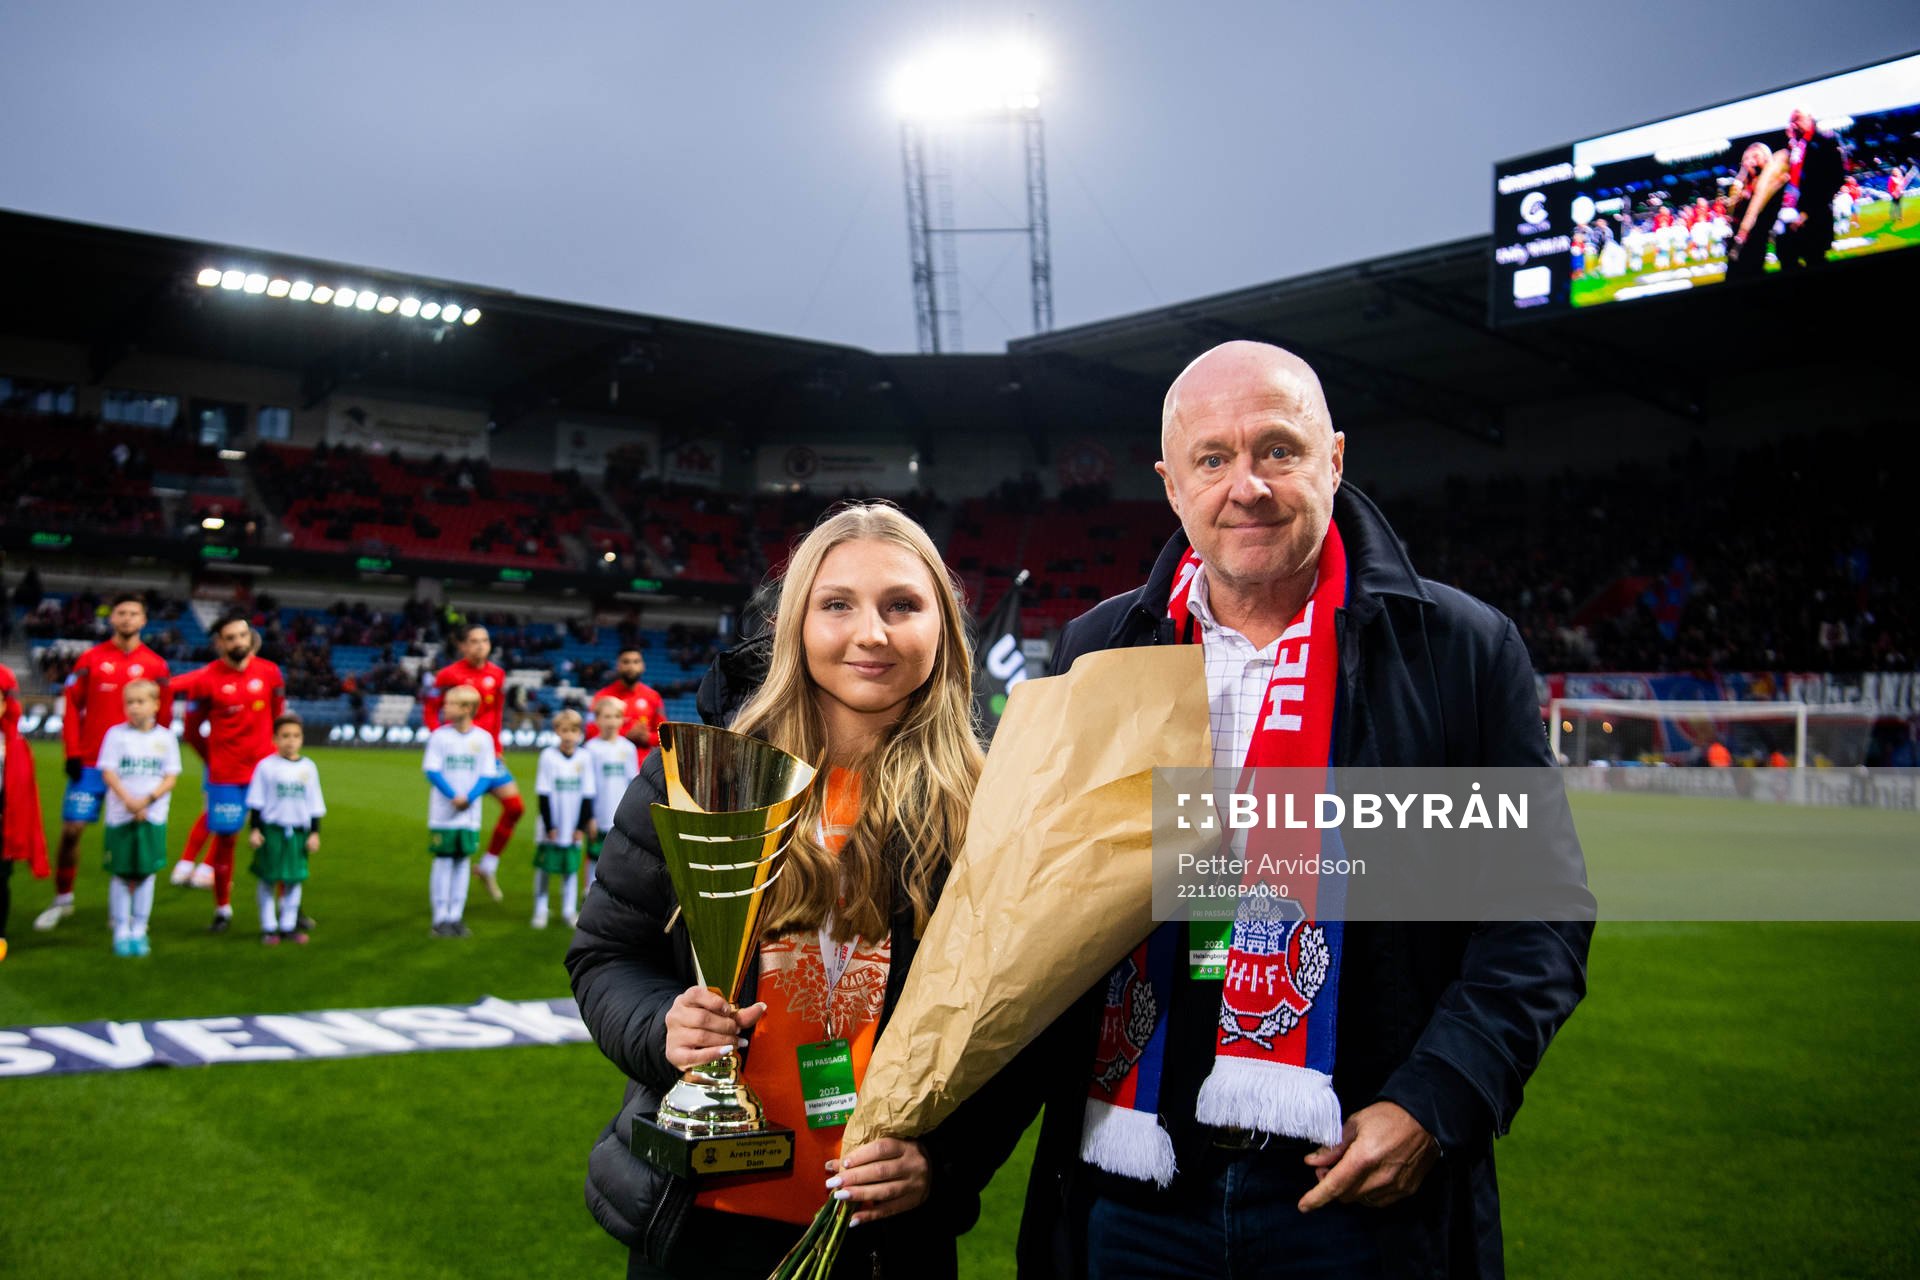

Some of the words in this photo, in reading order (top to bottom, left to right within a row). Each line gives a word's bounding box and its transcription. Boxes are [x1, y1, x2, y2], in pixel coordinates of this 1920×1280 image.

[1204, 940, 1225, 949] 2022
[803, 1060, 814, 1069] FRI
[815, 1054, 848, 1067] PASSAGE
[819, 1086, 840, 1098] 2022
[746, 1159, 765, 1167] Dam
